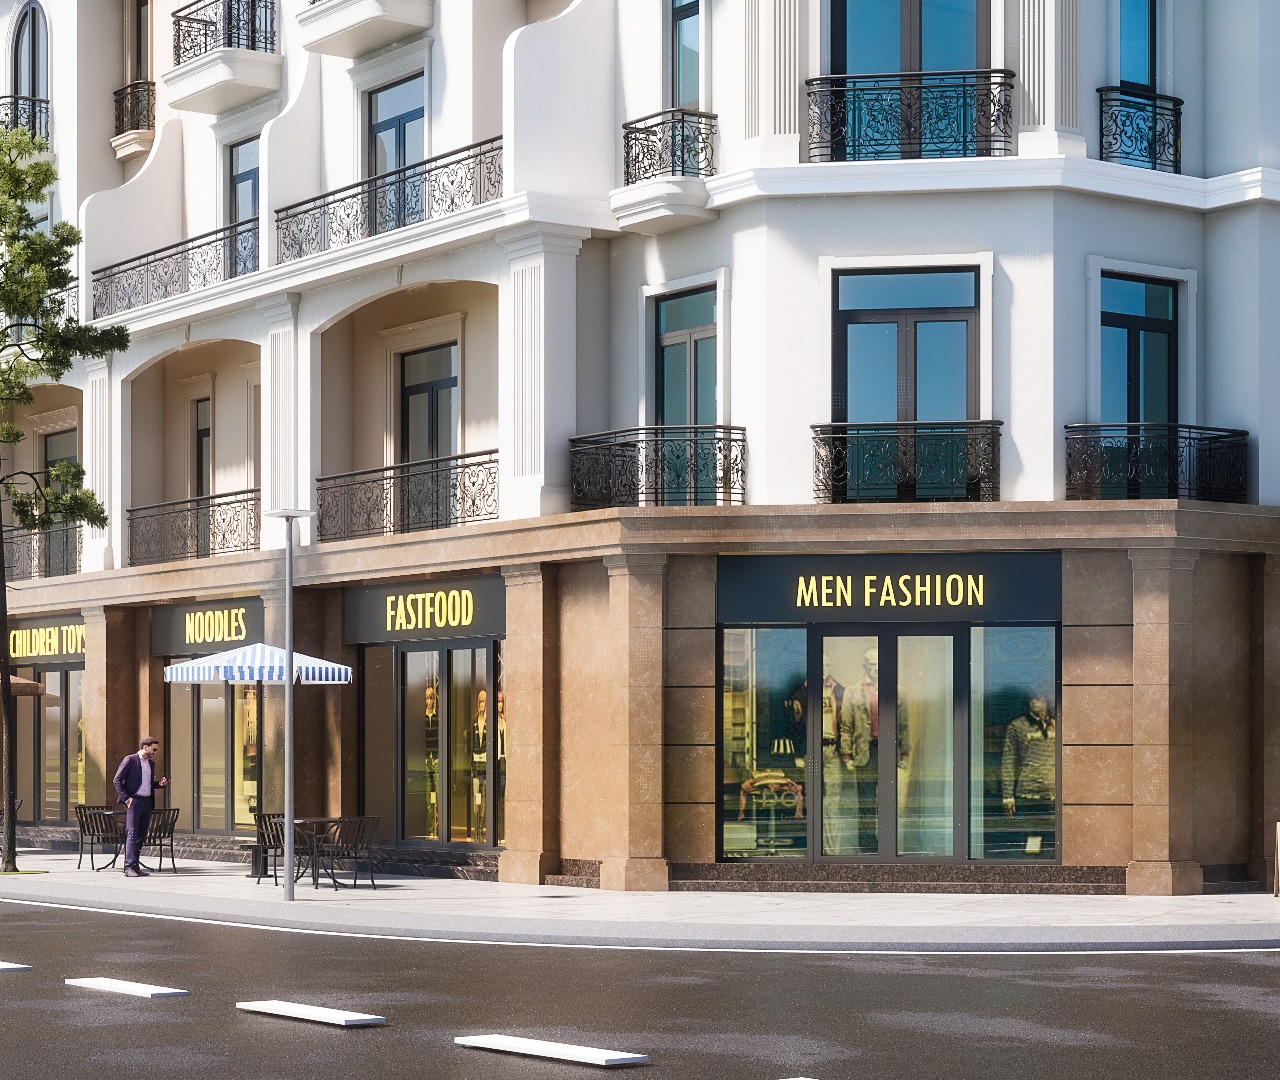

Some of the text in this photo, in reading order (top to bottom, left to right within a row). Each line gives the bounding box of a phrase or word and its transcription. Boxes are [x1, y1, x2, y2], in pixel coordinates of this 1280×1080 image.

[796, 574, 984, 607] MEN FASHION
[185, 607, 246, 644] NOODLES
[387, 589, 474, 631] FASTFOOD
[9, 626, 59, 659] CHILDREN
